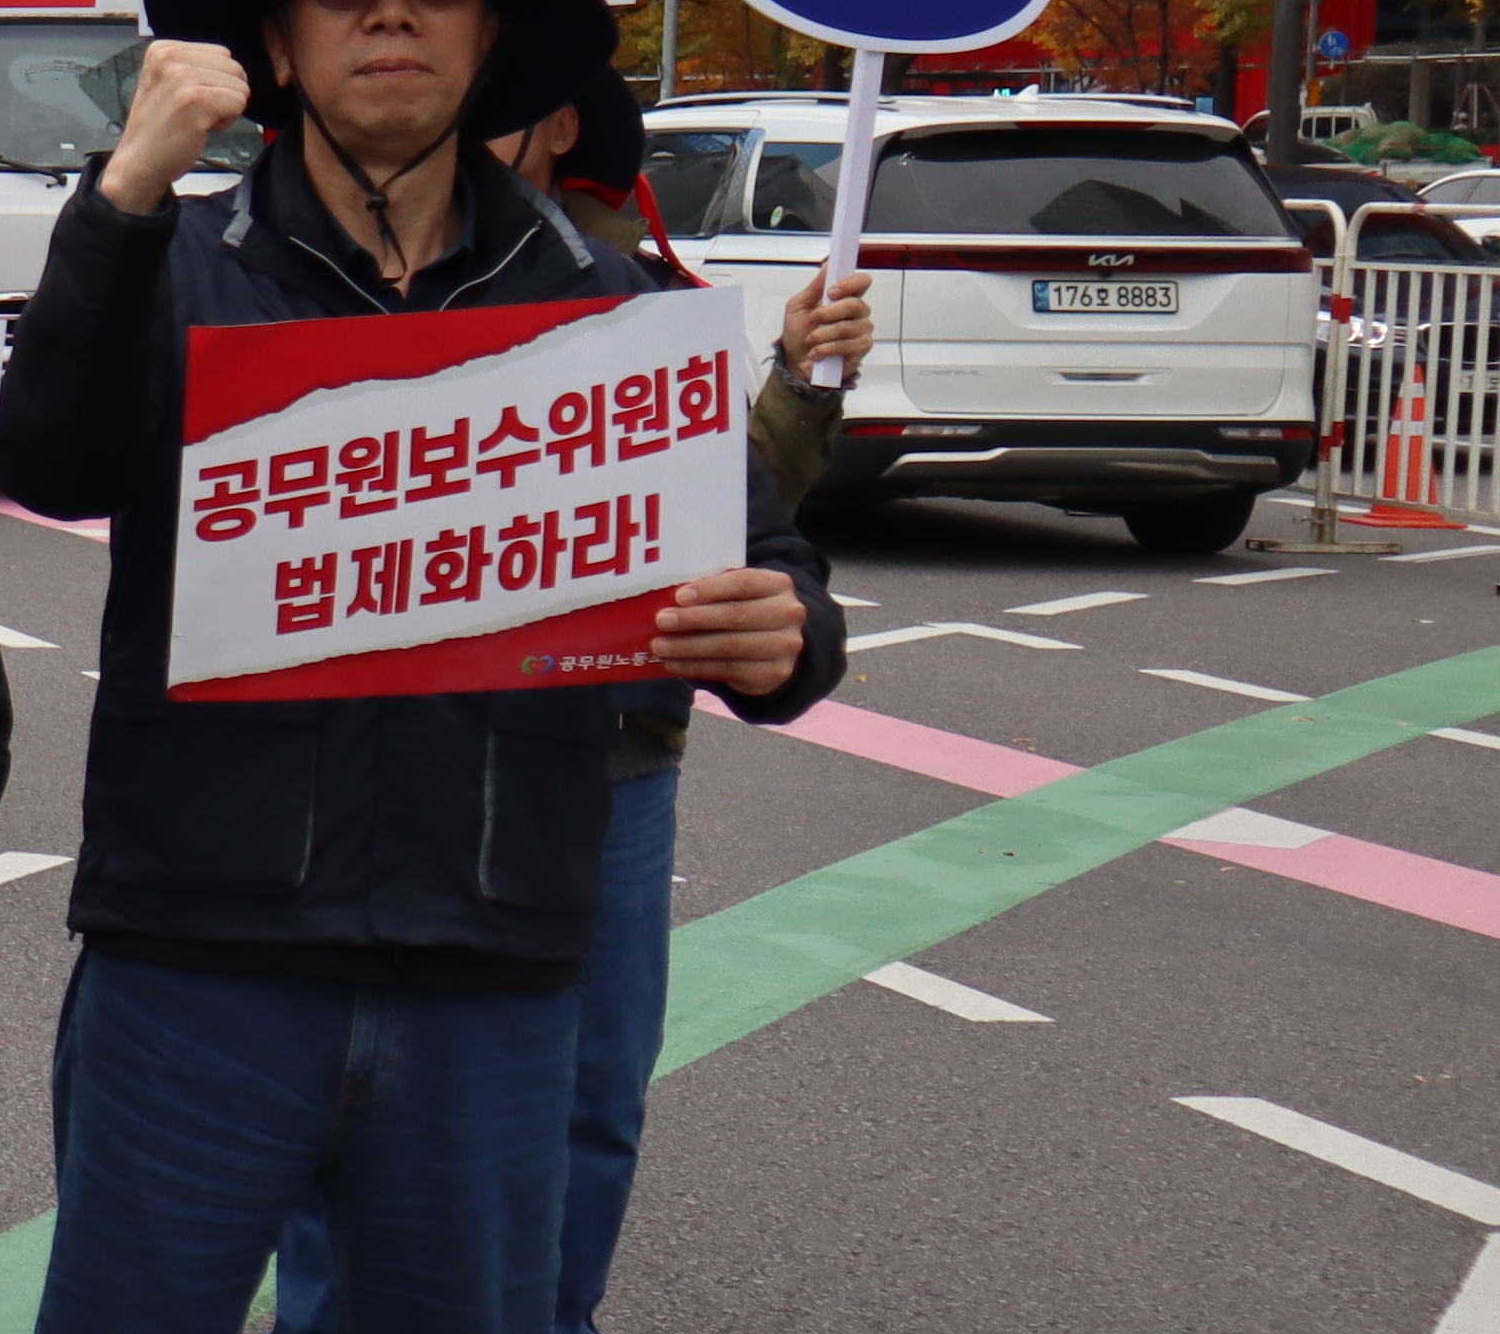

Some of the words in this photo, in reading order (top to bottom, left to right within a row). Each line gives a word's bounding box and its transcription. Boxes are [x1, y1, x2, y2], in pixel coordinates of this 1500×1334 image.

[1117, 285, 1172, 308] 8883
[194, 349, 731, 543] 공무원보수위원회
[275, 492, 662, 636] 법제화하라!
[559, 652, 664, 673] 공무원노동
